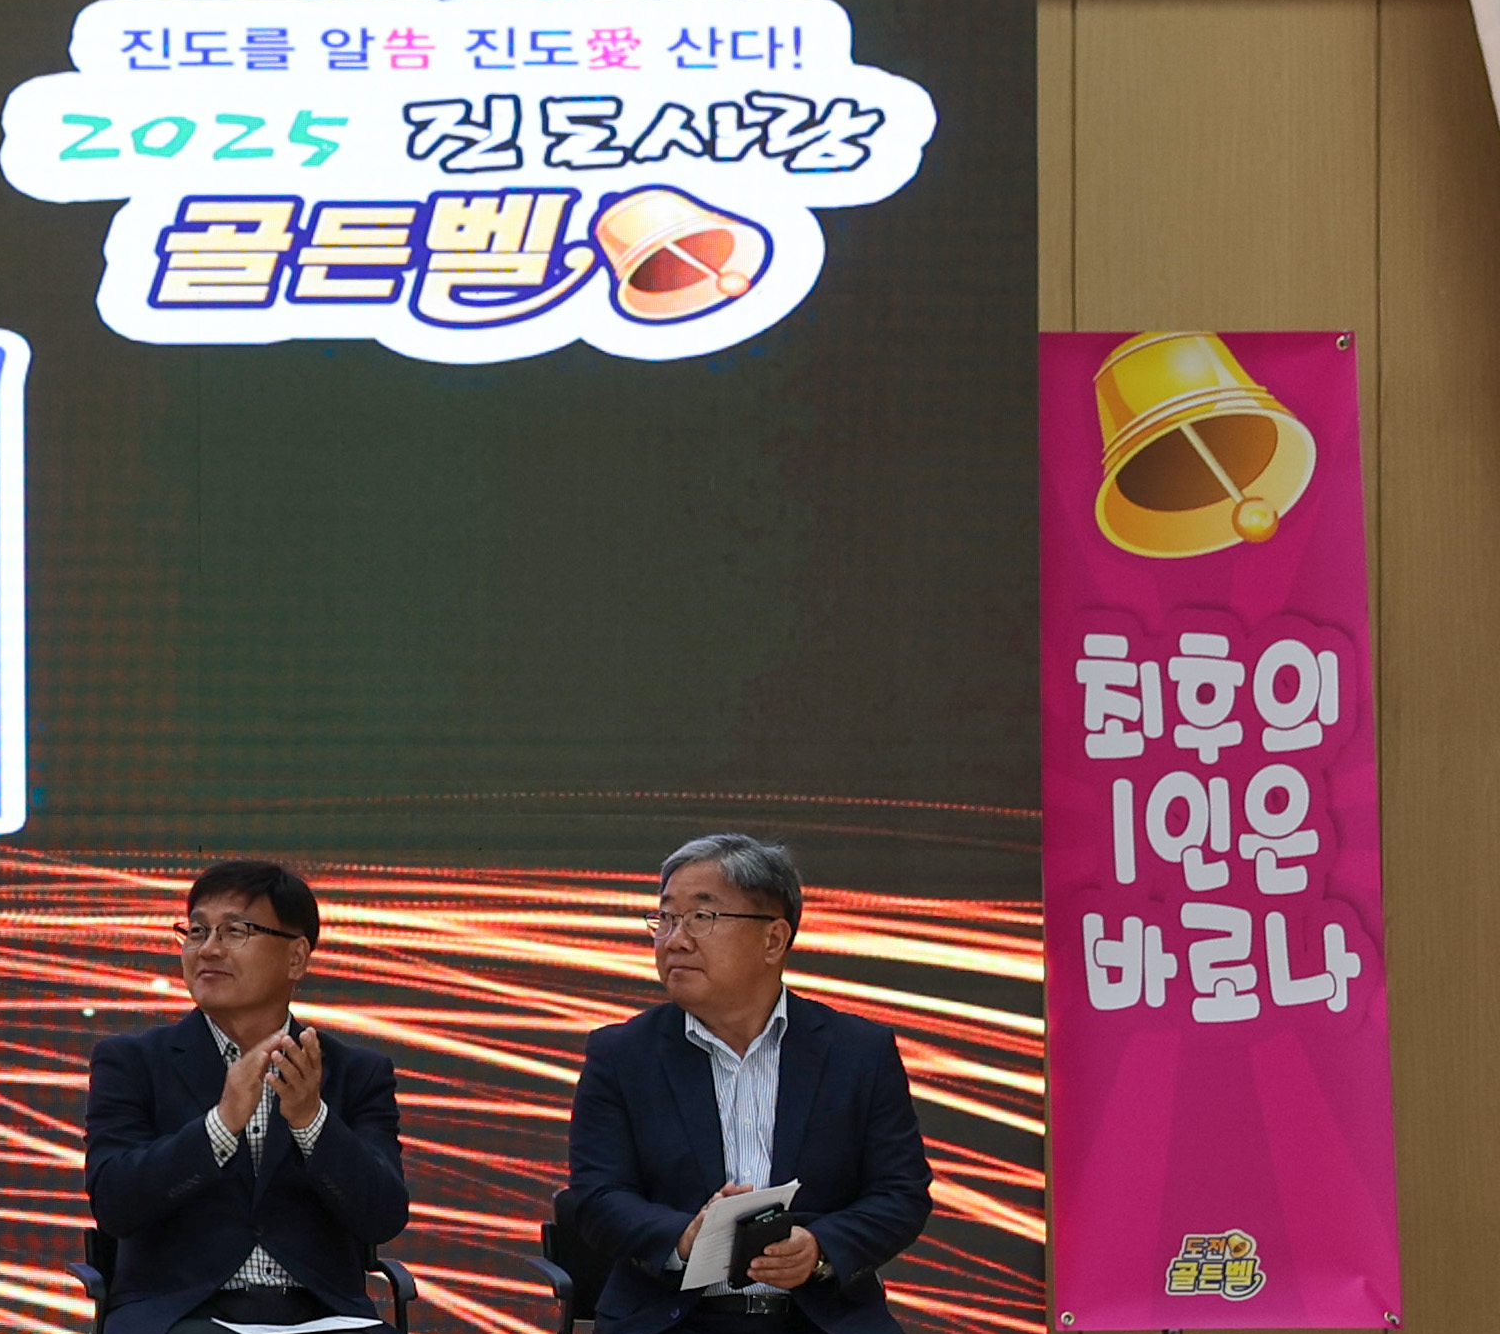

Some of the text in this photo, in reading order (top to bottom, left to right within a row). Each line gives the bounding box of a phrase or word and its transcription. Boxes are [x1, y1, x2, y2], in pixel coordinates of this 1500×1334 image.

[120, 26, 804, 70] 진도를 알告 진도愛 산다!
[59, 92, 887, 173] 2025 진도사랑
[147, 187, 595, 328] 골든벨
[1075, 632, 1340, 762] 최후의
[1168, 1258, 1263, 1298] 골든벨
[1182, 1236, 1227, 1260] 도전
